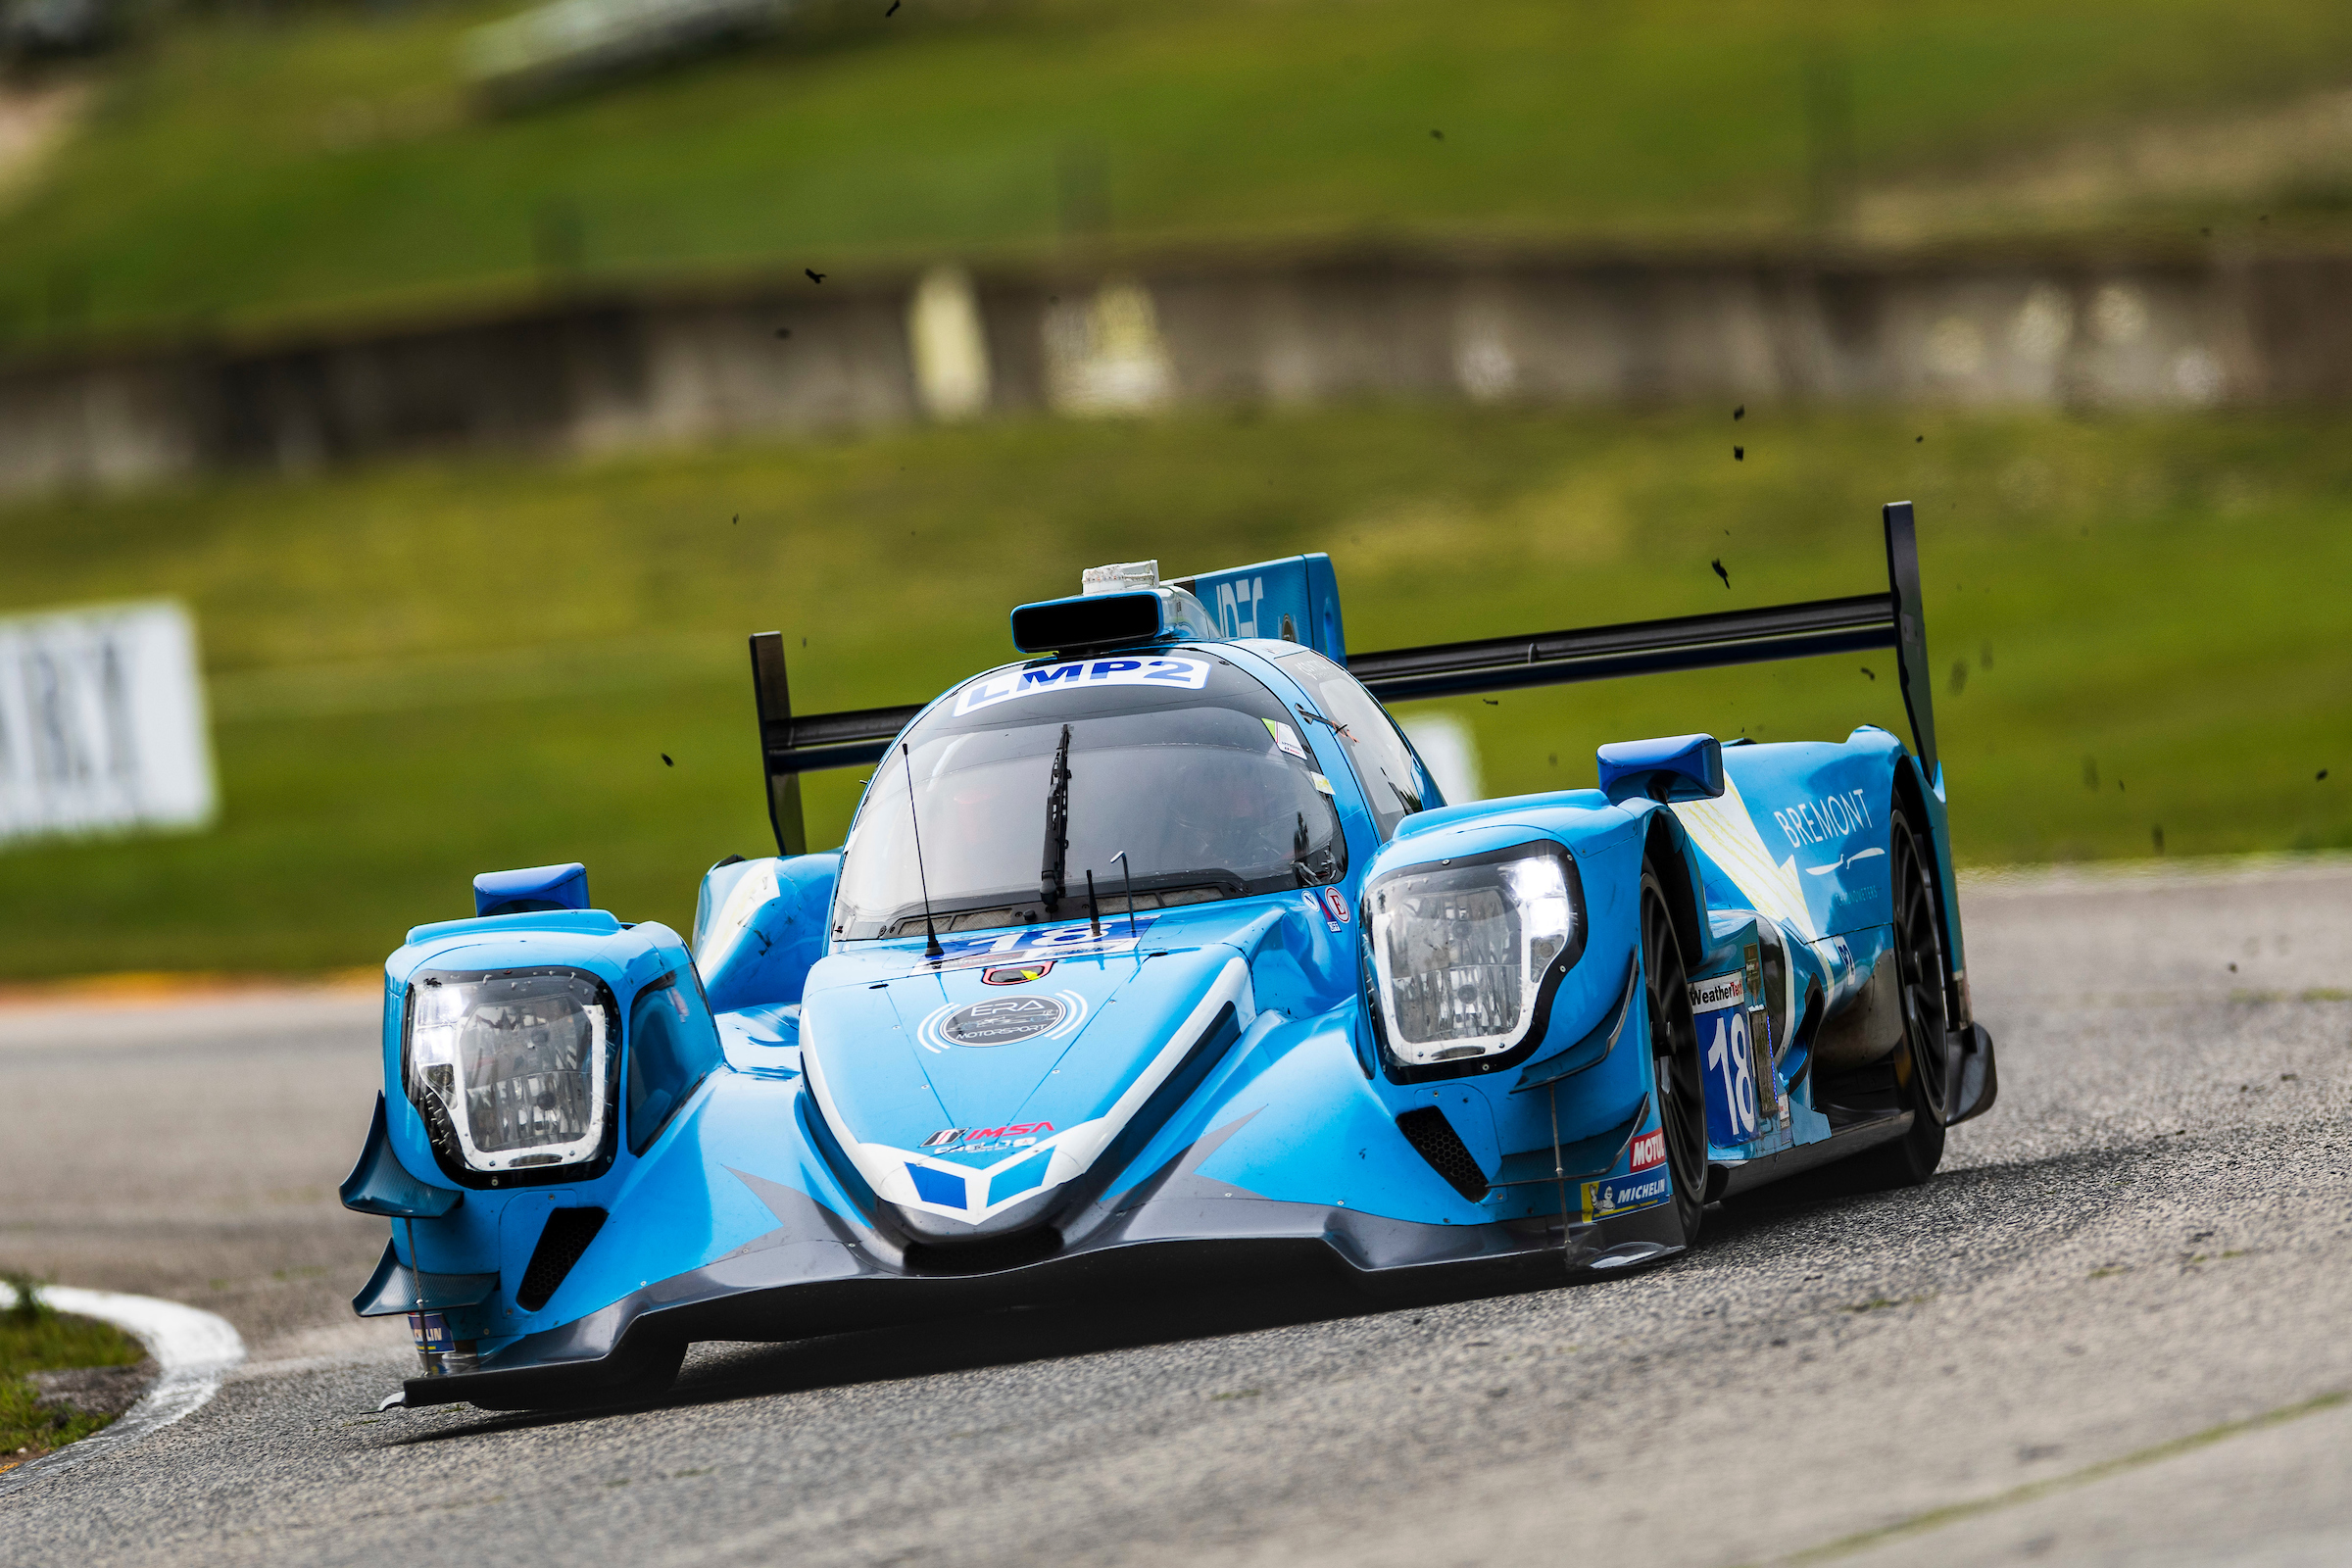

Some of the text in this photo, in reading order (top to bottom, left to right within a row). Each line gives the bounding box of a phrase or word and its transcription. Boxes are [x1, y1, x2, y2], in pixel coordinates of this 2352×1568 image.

[966, 660, 1195, 708] LMP2
[1774, 788, 1873, 848] BREMONT
[968, 923, 1112, 953] 18
[1689, 981, 1743, 1006] WeatherTech
[970, 1000, 1046, 1017] ERA
[955, 1023, 1048, 1040] MOTORSPORT
[1707, 1011, 1756, 1136] 18
[963, 1121, 1054, 1142] IMSA
[1632, 1132, 1664, 1167] MOTUL
[1617, 1178, 1665, 1204] MICHELIN
